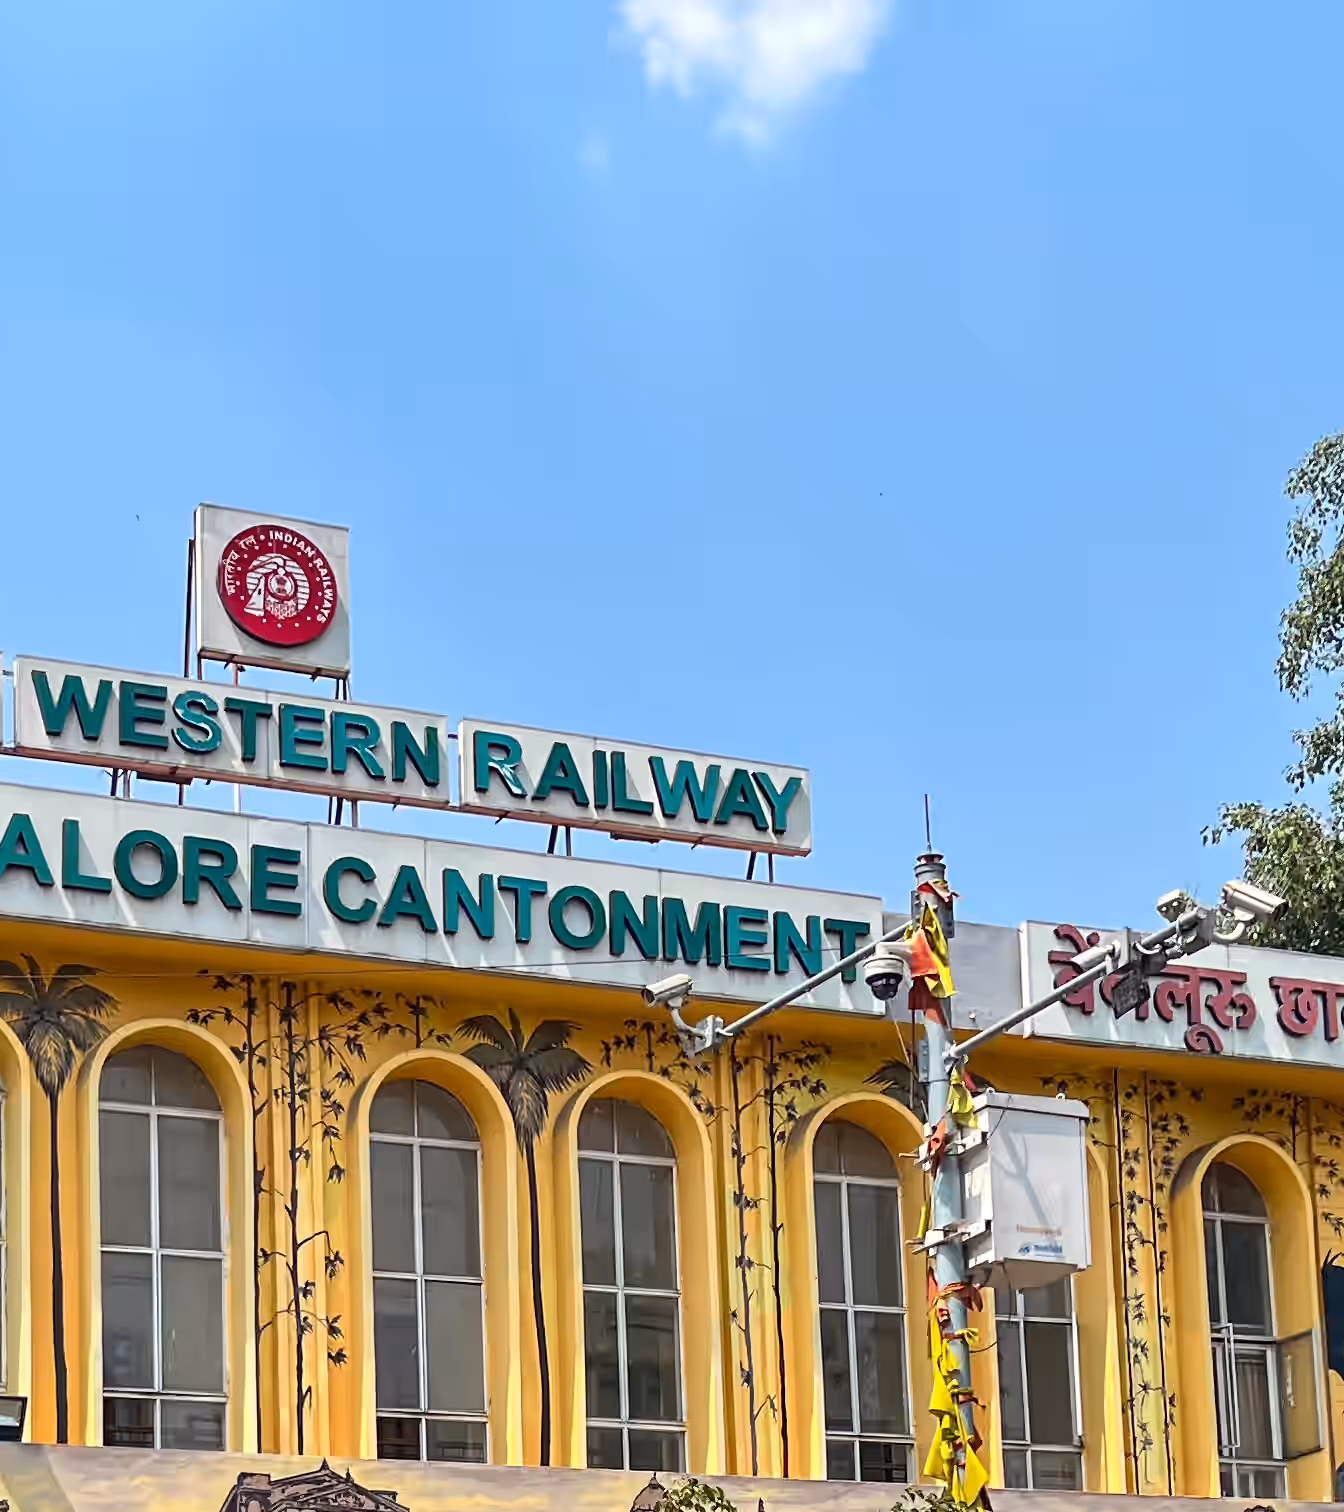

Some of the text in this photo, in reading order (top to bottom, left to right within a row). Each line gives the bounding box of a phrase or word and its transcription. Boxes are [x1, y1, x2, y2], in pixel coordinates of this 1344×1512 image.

[269, 530, 335, 623] INDIAN RAILWAYS
[30, 668, 442, 787] WESTERN
[472, 731, 803, 834] RAILWAY
[322, 856, 870, 985] CANTONMENT
